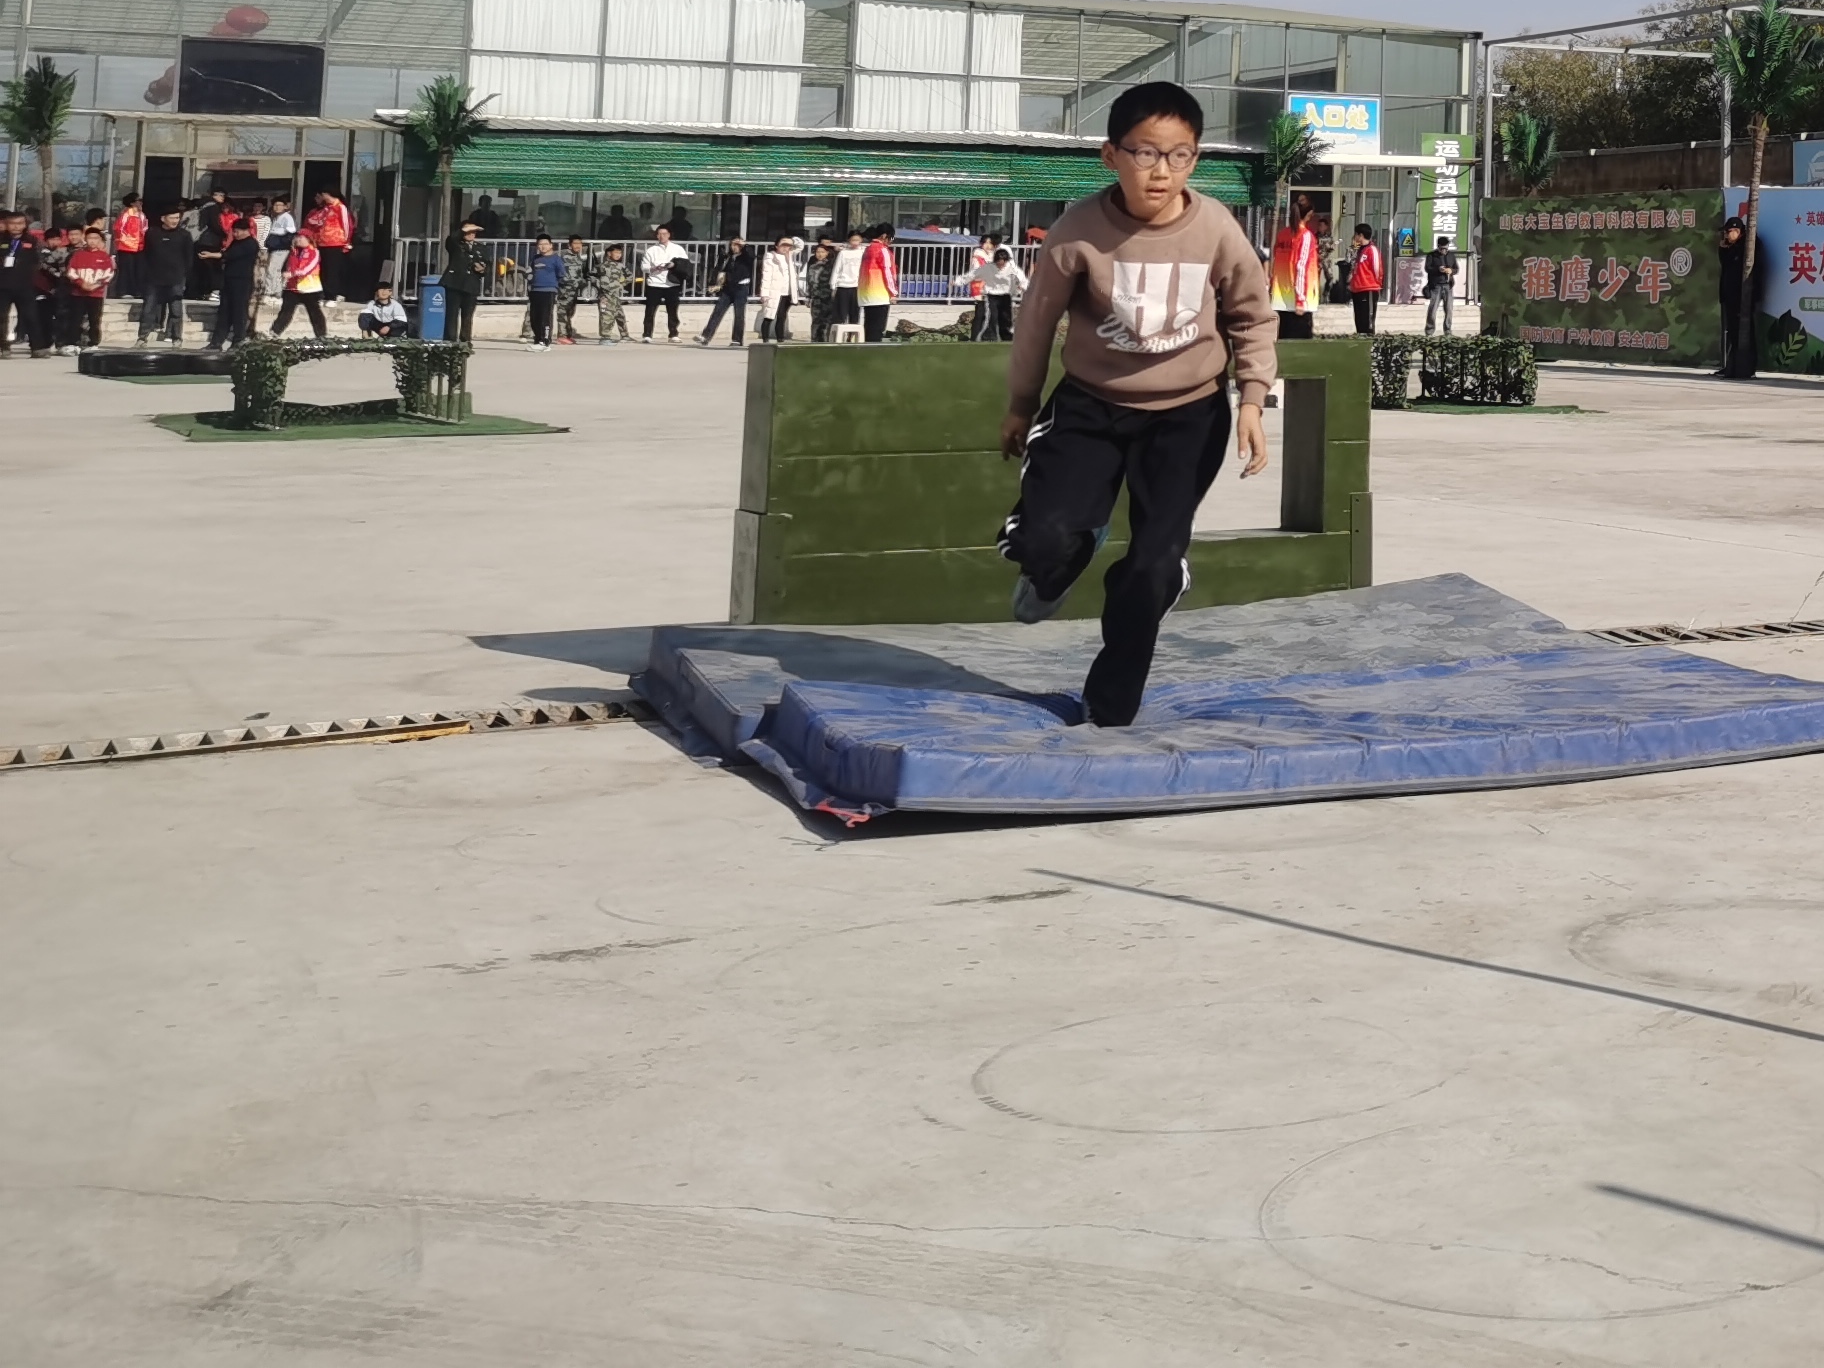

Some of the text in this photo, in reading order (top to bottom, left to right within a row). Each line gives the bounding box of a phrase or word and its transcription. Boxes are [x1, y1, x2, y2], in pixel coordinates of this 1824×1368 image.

[1301, 103, 1369, 130] 入口处
[1500, 209, 1697, 231] 山东大宝生存教育科技有限公司
[1521, 255, 1672, 304] 稚鹰少年
[1519, 325, 1670, 350] 国防教育 户外教育 安全教育
